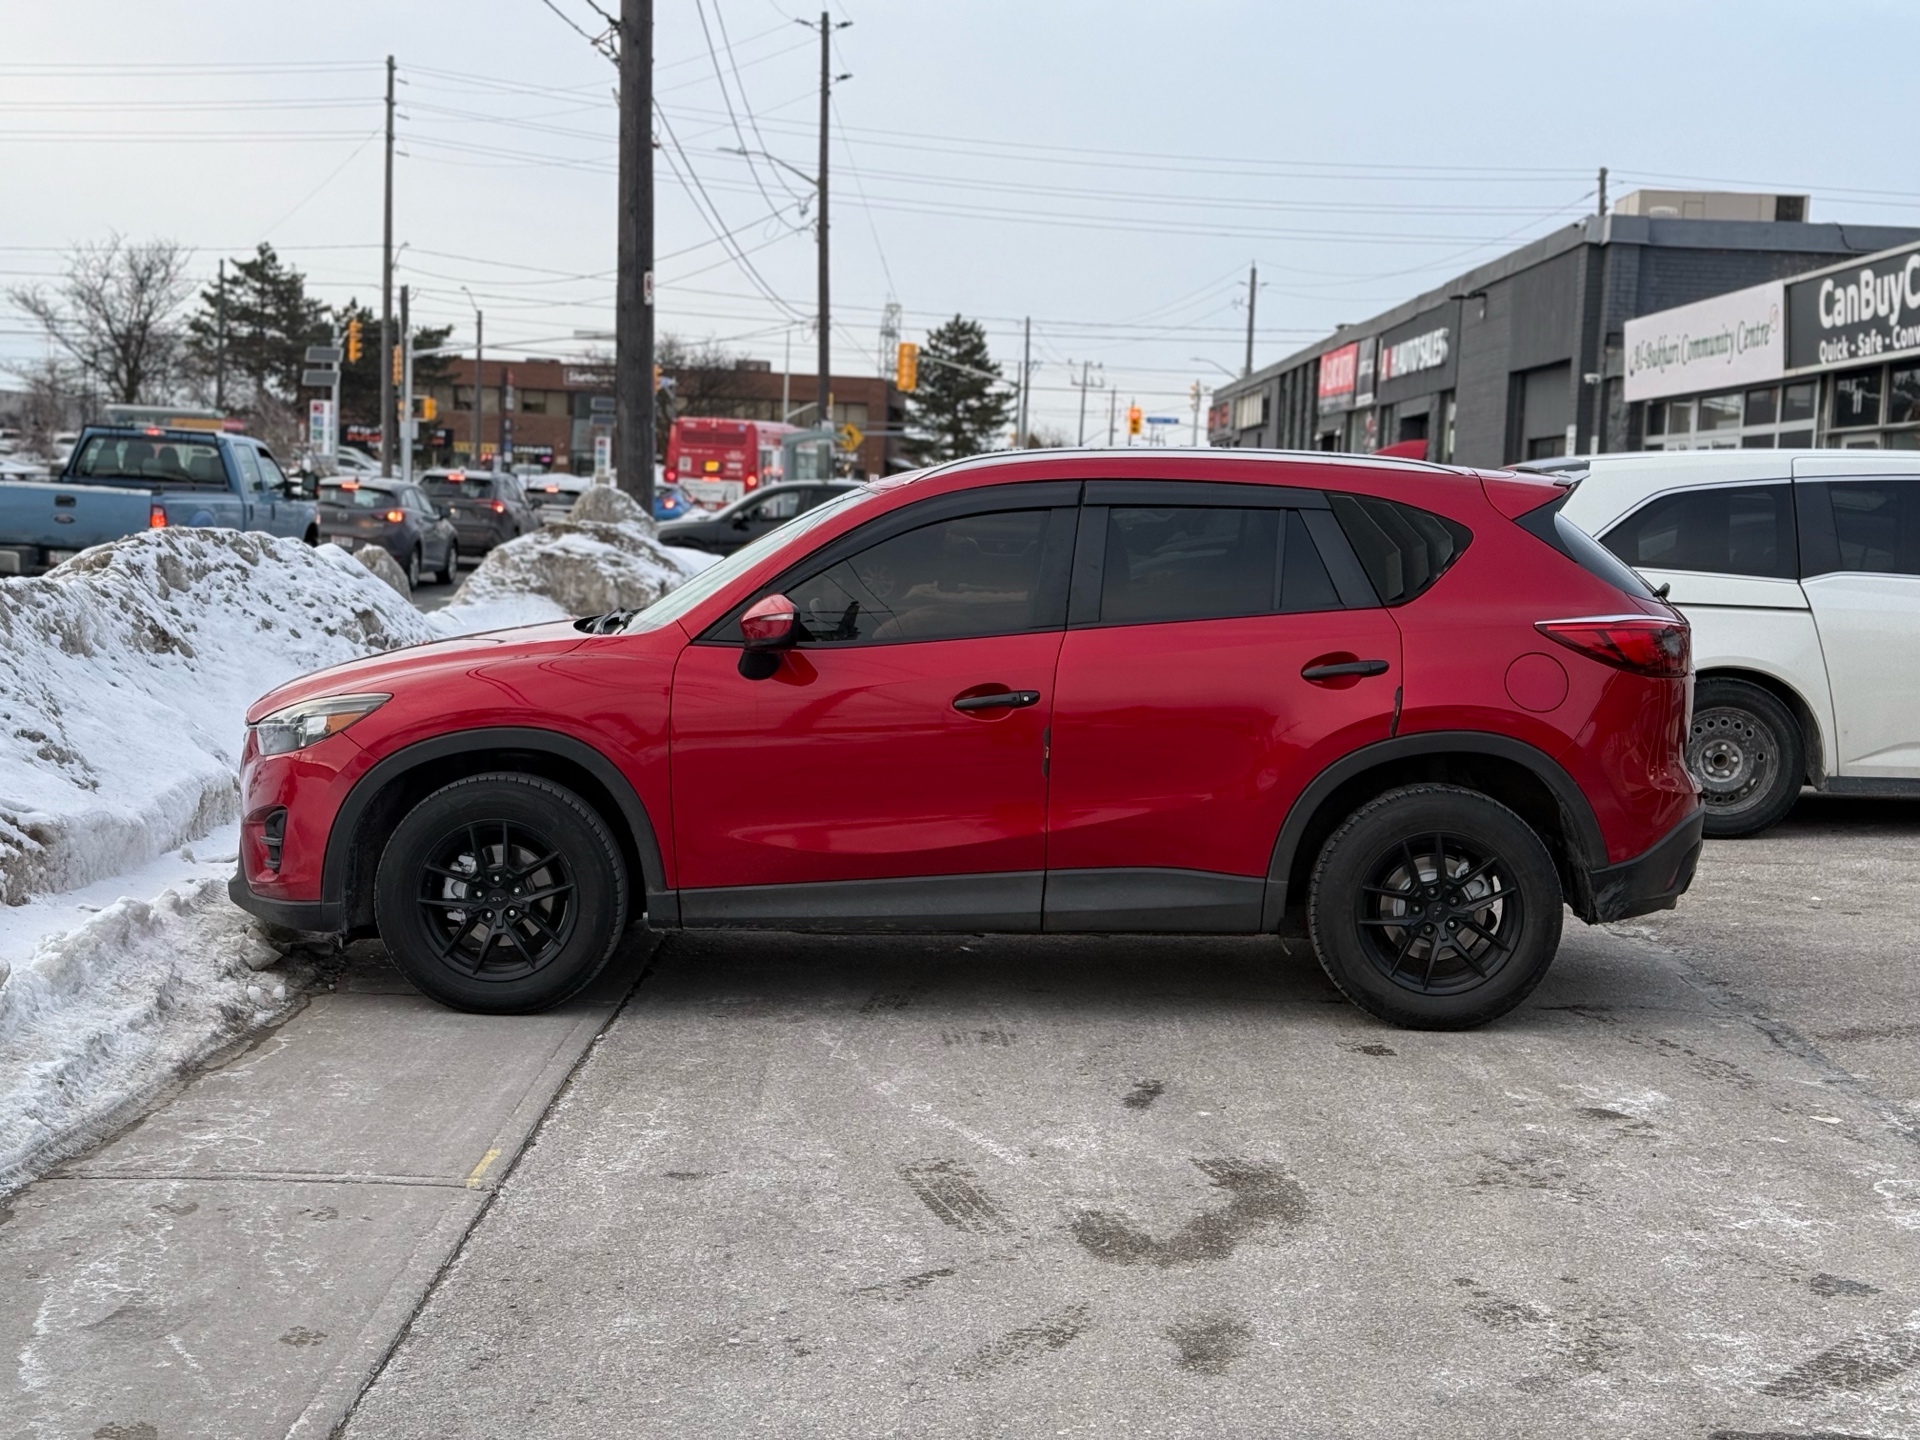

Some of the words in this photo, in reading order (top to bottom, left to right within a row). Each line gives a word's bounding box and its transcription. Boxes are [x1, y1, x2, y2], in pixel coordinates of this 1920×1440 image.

[1819, 253, 1920, 329] CanBuyC
[1681, 324, 1735, 366] Community
[1737, 320, 1771, 355] Centre
[1819, 335, 1849, 365] Quick
[1858, 328, 1883, 357] Safe
